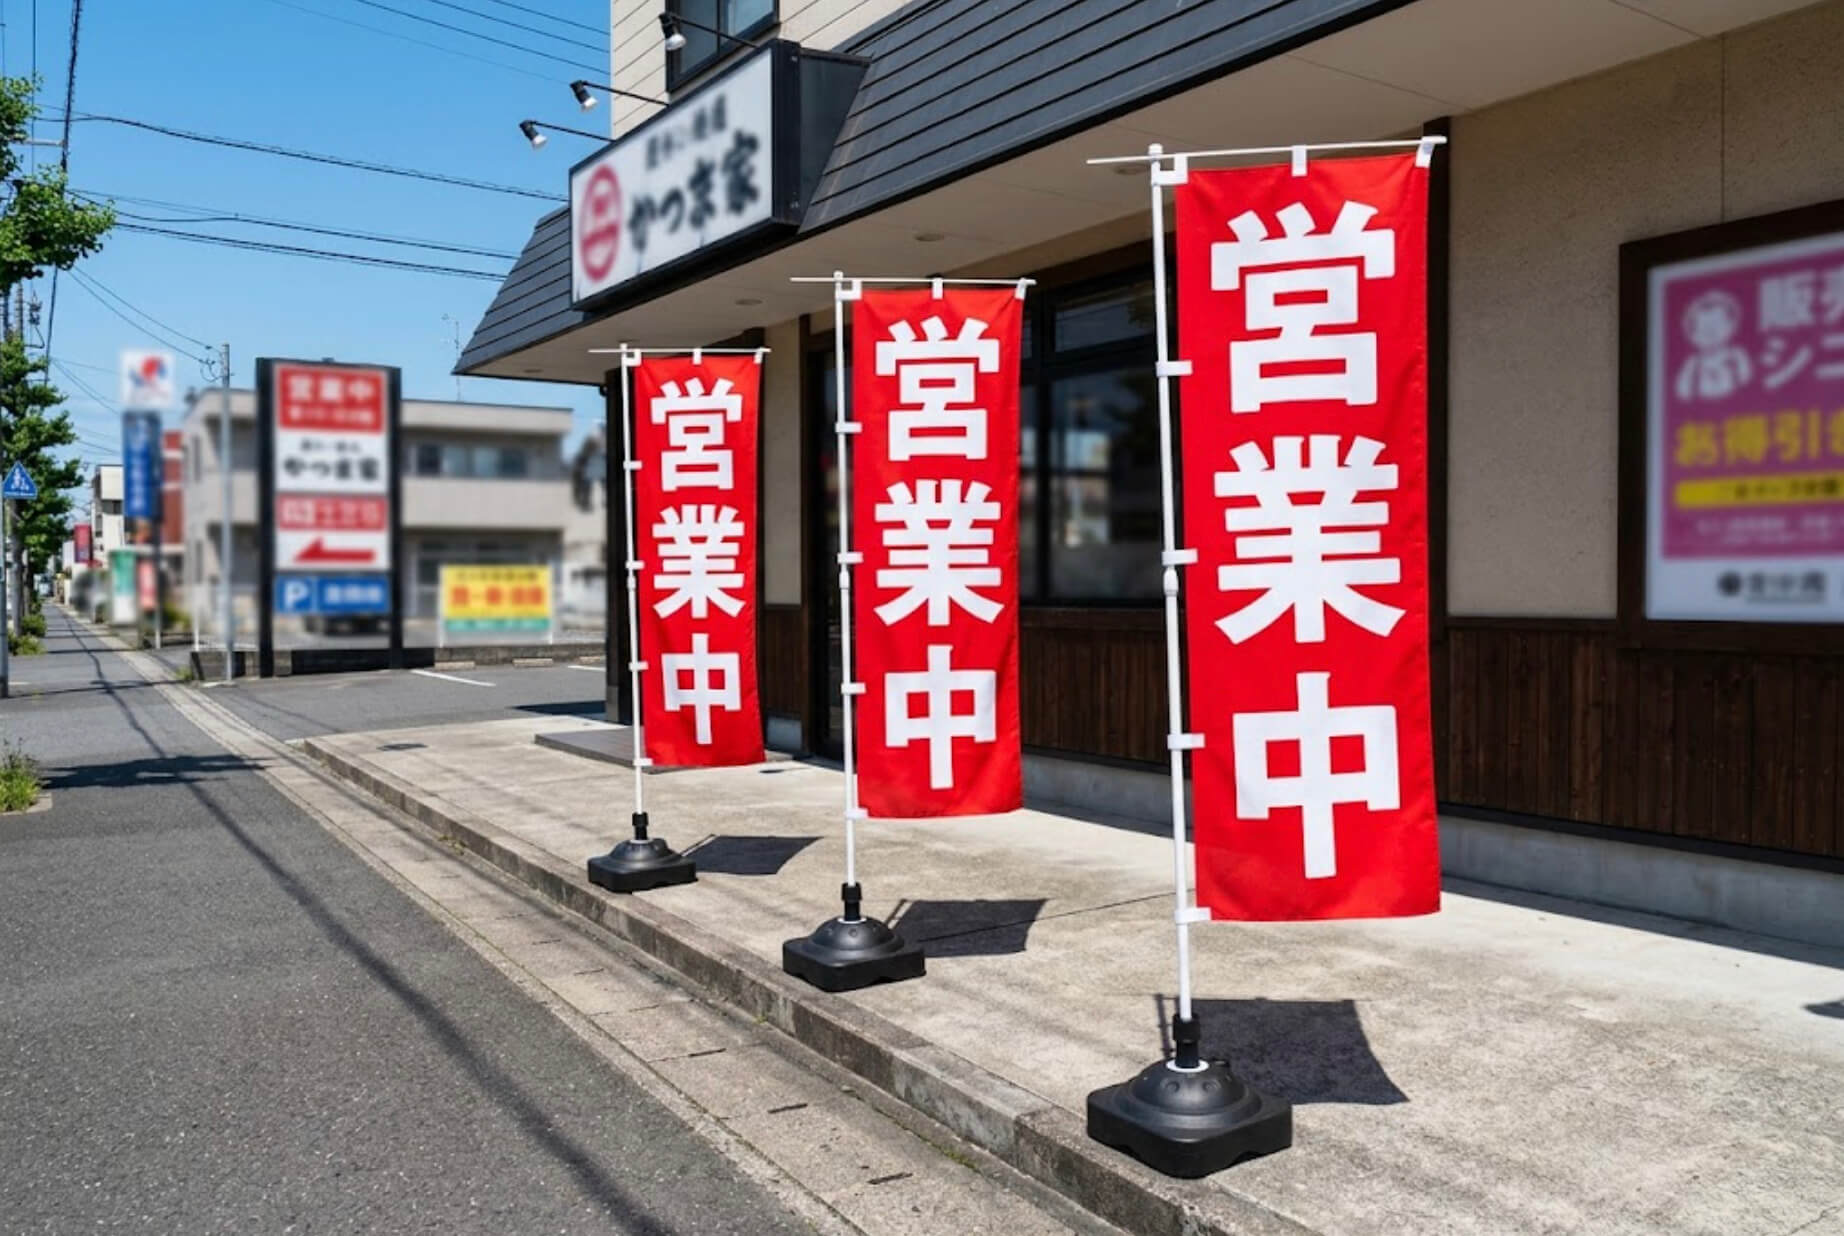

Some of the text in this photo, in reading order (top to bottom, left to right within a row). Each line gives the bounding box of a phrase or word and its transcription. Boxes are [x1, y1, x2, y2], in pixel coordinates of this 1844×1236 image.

[284, 580, 309, 608] P
[650, 376, 746, 746] 営業中
[874, 315, 1004, 790] 営業中
[1210, 199, 1406, 881] 営業中
